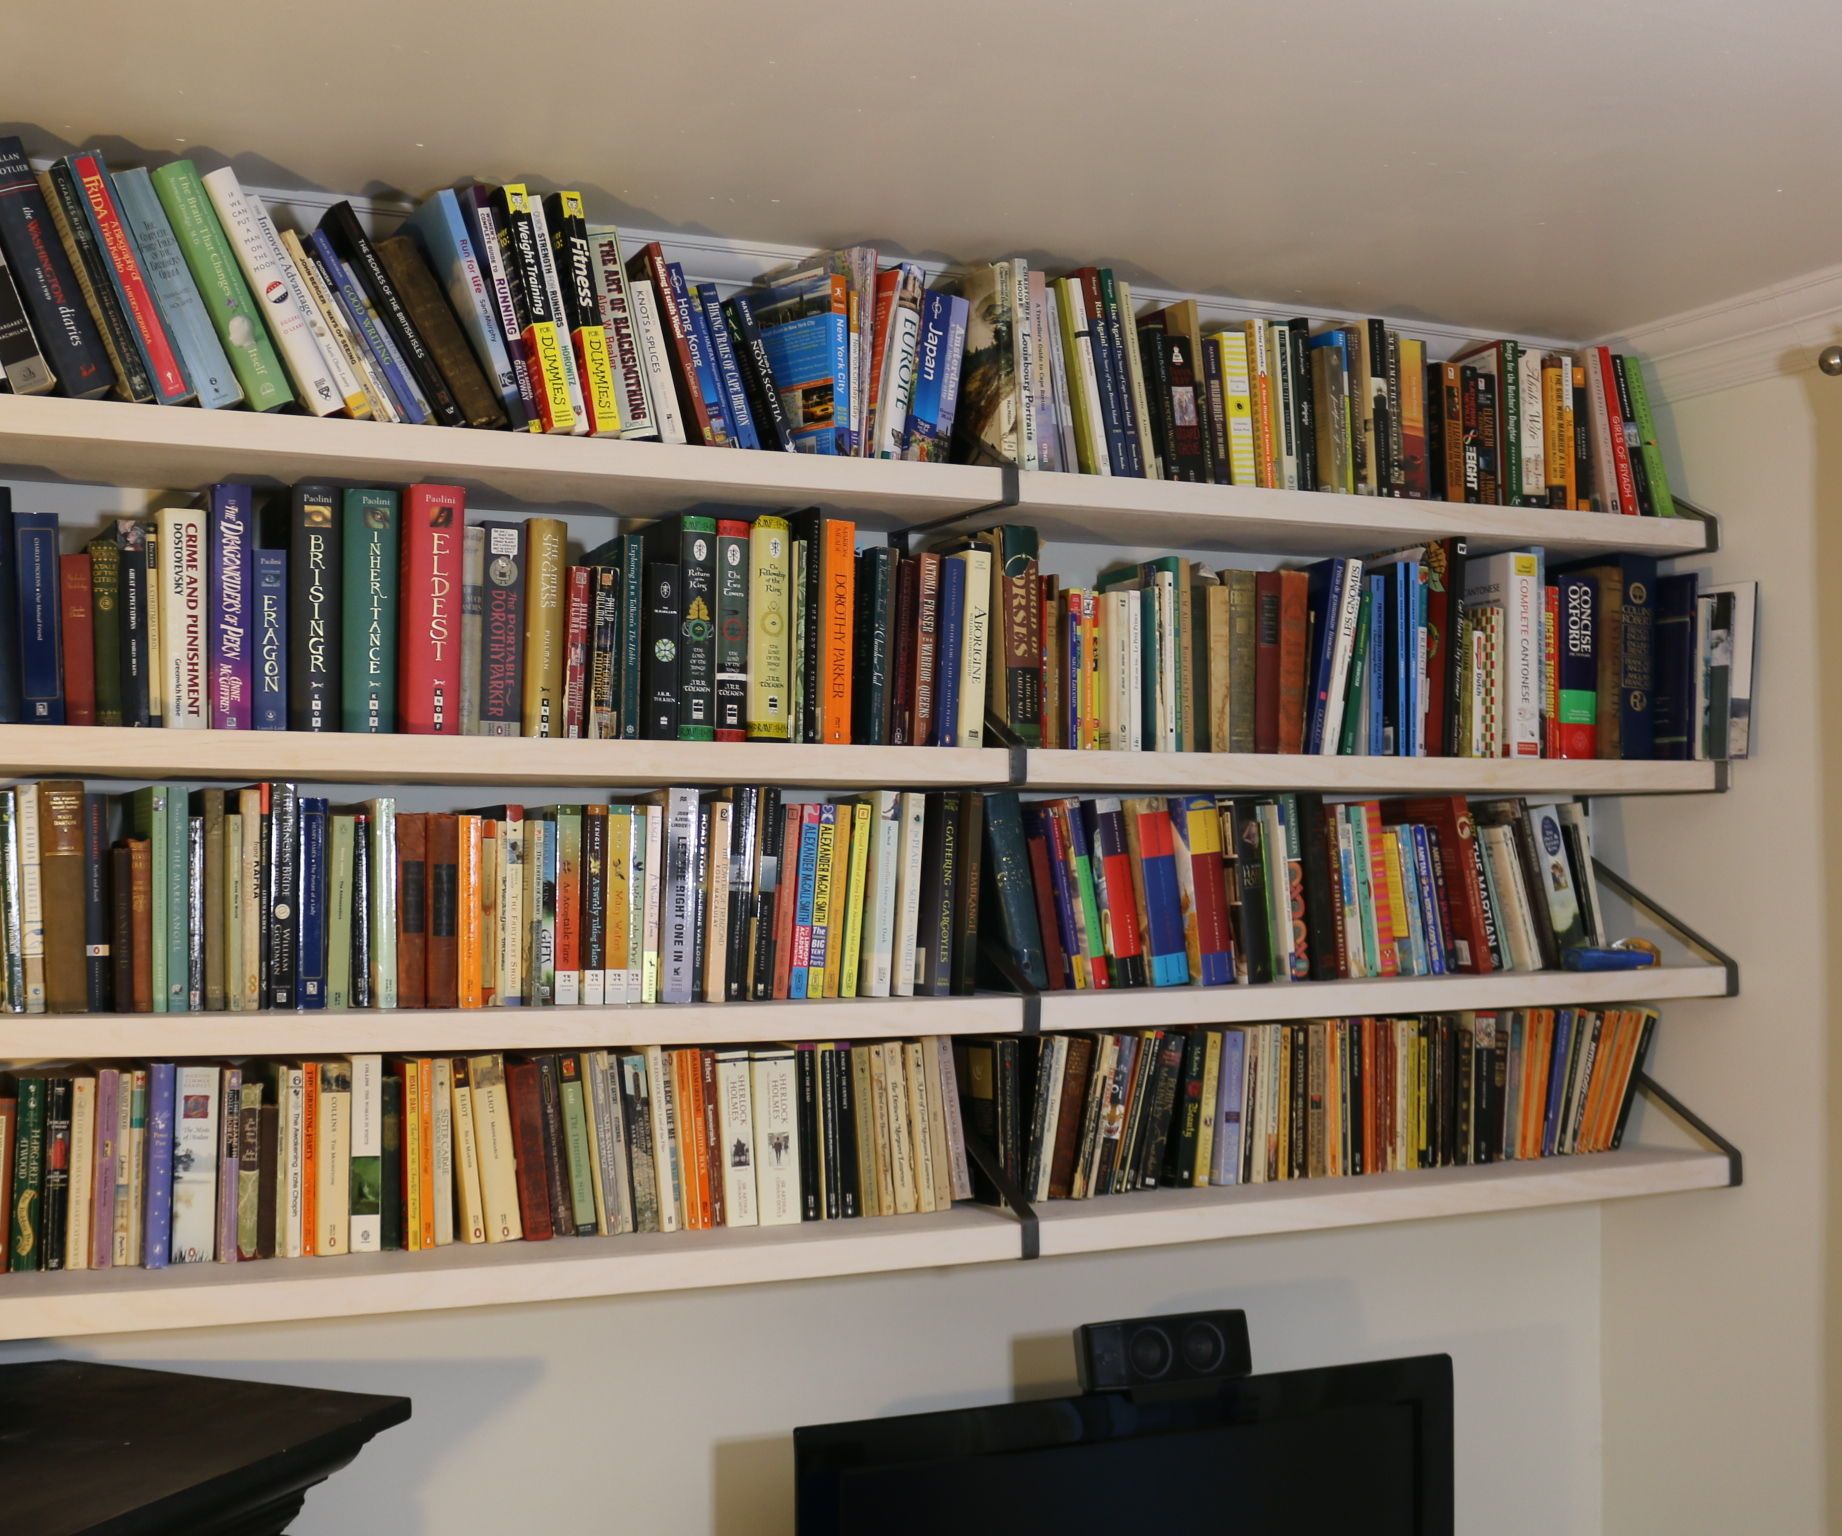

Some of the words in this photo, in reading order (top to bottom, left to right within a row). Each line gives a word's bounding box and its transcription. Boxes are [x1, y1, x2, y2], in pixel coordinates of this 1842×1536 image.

[82, 174, 109, 220] FRIDA
[232, 209, 248, 218] CAN
[244, 235, 261, 246] MAN
[459, 238, 471, 260] Run
[598, 239, 614, 268] THE
[26, 217, 66, 306] WASHINGTON
[58, 304, 83, 348] diaries
[258, 216, 287, 264] Introvert
[282, 262, 313, 316] Advantage
[517, 220, 531, 262] Weight
[526, 257, 545, 317] Training
[569, 236, 594, 309] Fitness
[604, 269, 622, 296] ART
[187, 196, 202, 226] Brain
[200, 226, 213, 252] That
[209, 250, 233, 297] Changes
[247, 347, 267, 376] Itself
[311, 279, 328, 305] BERGER
[358, 238, 370, 256] THE
[367, 255, 387, 288] PEOPLES
[388, 296, 401, 313] THE
[397, 310, 416, 342] BRITISH
[411, 336, 425, 360] ISLES
[496, 278, 518, 336] RUNNING
[609, 296, 626, 315] OF
[707, 301, 721, 334] HIKING
[1109, 302, 1118, 320] Rise
[343, 284, 365, 317] GOOD
[362, 319, 392, 367] WRITING
[636, 290, 651, 328] KNOTS
[645, 335, 662, 375] SPLICES
[676, 298, 694, 333] Hong
[686, 333, 703, 369] Kong
[835, 318, 845, 343] New
[541, 335, 567, 407] DUMMIES
[560, 344, 577, 387] HOROWITZ
[612, 314, 648, 422] BLACKSMITHING
[834, 345, 845, 370] York
[896, 316, 917, 411] EUROPE
[923, 324, 944, 382] Japan
[1021, 332, 1033, 394] Louisbourg
[588, 338, 612, 410] DUMMIES
[751, 341, 769, 377] NOVA
[762, 376, 783, 424] SCOTIA
[836, 370, 846, 394] City
[1024, 394, 1035, 441] Portraits
[1612, 416, 1624, 443] GIRLS
[1466, 450, 1478, 491] EIGHT
[1616, 446, 1626, 460] OF
[1620, 463, 1633, 498] RIYADH
[303, 494, 332, 505] Paolini
[362, 496, 391, 507] Paolini
[425, 494, 456, 504] Paolini
[173, 522, 184, 596] DOSTOYEVSKY
[185, 522, 199, 572] CRIME
[627, 543, 639, 580] Exploring
[541, 532, 553, 609] SPYGLASS
[550, 564, 560, 609] AMBER
[687, 568, 711, 578] Return
[688, 579, 708, 592] King
[758, 569, 787, 581] Fellowship
[924, 557, 938, 595] ANTONIA
[186, 575, 199, 610] AND
[308, 534, 326, 674] BRISINGR
[369, 531, 388, 674] INHERITANCE
[429, 533, 450, 662] ELDEST
[723, 587, 744, 598] Towers
[765, 583, 782, 597] Ring
[833, 572, 848, 644] DOROTHY
[1346, 564, 1361, 620] GNOMES
[1520, 579, 1529, 636] COMPLETE
[490, 589, 508, 655] DOROTHY
[606, 594, 616, 623] PHILIP
[627, 597, 637, 628] Tolkien's
[921, 599, 937, 633] FRASER
[1568, 585, 1580, 652] OXFORD
[1580, 586, 1592, 653] CONCISE
[262, 595, 280, 693] ERAGON
[970, 604, 988, 685] ABORIGINE
[1343, 621, 1351, 638] LES
[186, 614, 201, 718] PUNISHMENT
[505, 611, 519, 689] PORTABLE
[920, 643, 935, 683] WARRIOR
[487, 655, 506, 718] PARKER
[682, 684, 711, 693] TOLKIEN
[758, 679, 785, 690] TOLKIEN
[831, 646, 847, 700] PARKER
[1520, 638, 1530, 704] CANTONESE
[434, 689, 443, 731] KNOPF
[717, 688, 745, 698] TOLKIEN
[917, 683, 932, 720] QUEENS
[593, 820, 601, 851] L'ENGLE
[802, 824, 817, 874] ALEXANDER
[818, 825, 833, 874] ALEXANDER
[174, 850, 182, 870] THE
[943, 825, 955, 886] GATHERING
[1473, 840, 1484, 872] THE
[172, 872, 182, 905] MARK
[281, 864, 292, 897] BRIDE
[561, 897, 571, 941] Acceptable
[591, 887, 603, 917] Swiftly
[615, 889, 625, 917] Many
[674, 885, 686, 921] RIGHT
[798, 904, 810, 924] SMITH
[814, 904, 826, 925] SMITH
[1477, 875, 1498, 948] MARTIAN
[172, 914, 181, 952] ANGEL
[540, 929, 553, 965] GIFTS
[612, 919, 623, 953] Waters
[673, 923, 685, 947] ONE
[812, 939, 825, 949] BIG
[813, 928, 826, 936] The
[940, 899, 951, 964] GARGOYLES
[272, 925, 282, 976] GOLDMAN
[281, 928, 291, 973] WILLIAM
[561, 941, 570, 964] Time
[590, 942, 599, 968] Planet
[673, 949, 684, 964] IN
[802, 935, 810, 967] LIMPOPO
[305, 1071, 313, 1088] THE
[663, 1080, 672, 1106] BLACK
[304, 1088, 313, 1134] SHOOTING
[409, 1095, 417, 1115] DAHL
[459, 1093, 469, 1118] ELIOT
[486, 1089, 496, 1115] ELIOT
[729, 1080, 739, 1122] HOLMES
[737, 1072, 748, 1126] SHERLOCK
[771, 1079, 781, 1121] HOLMES
[778, 1072, 789, 1124] SHERLOCK
[440, 1109, 450, 1139] SISTER
[666, 1106, 674, 1127] LIKE
[669, 1127, 676, 1141] ME
[1182, 1102, 1199, 1138] Beauty
[18, 1136, 29, 1181] ATWOOD
[29, 1128, 42, 1185] MARGARET
[303, 1134, 313, 1162] PARTY
[441, 1141, 450, 1176] CARRIE
[291, 1187, 299, 1218] Chopin
